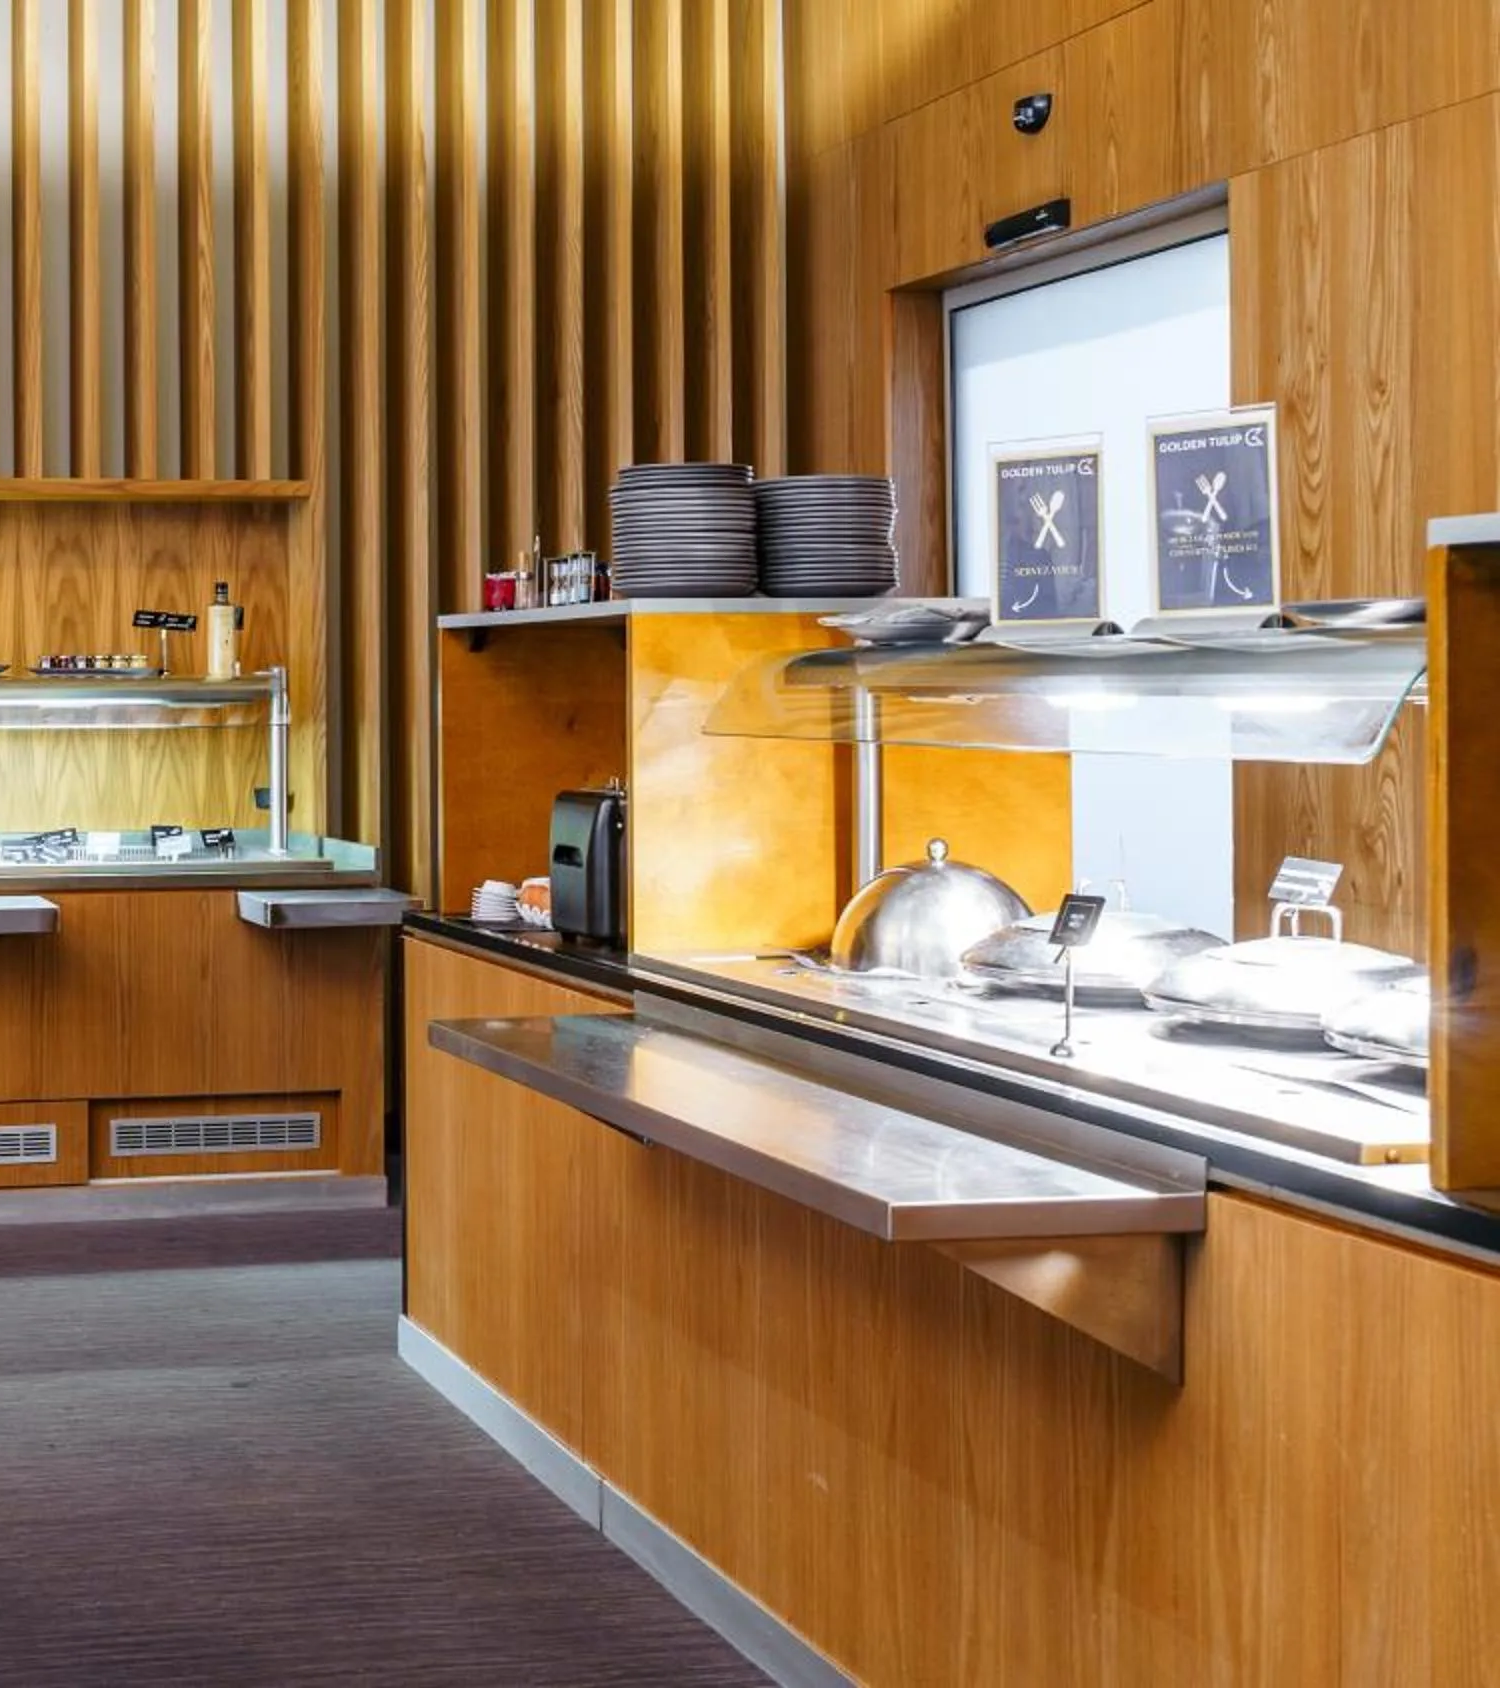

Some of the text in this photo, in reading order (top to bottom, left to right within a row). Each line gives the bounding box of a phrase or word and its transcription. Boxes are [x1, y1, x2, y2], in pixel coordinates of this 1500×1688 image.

[1158, 433, 1243, 453] GOLDEN TULIP
[1001, 463, 1077, 479] GOLDEN TULIP
